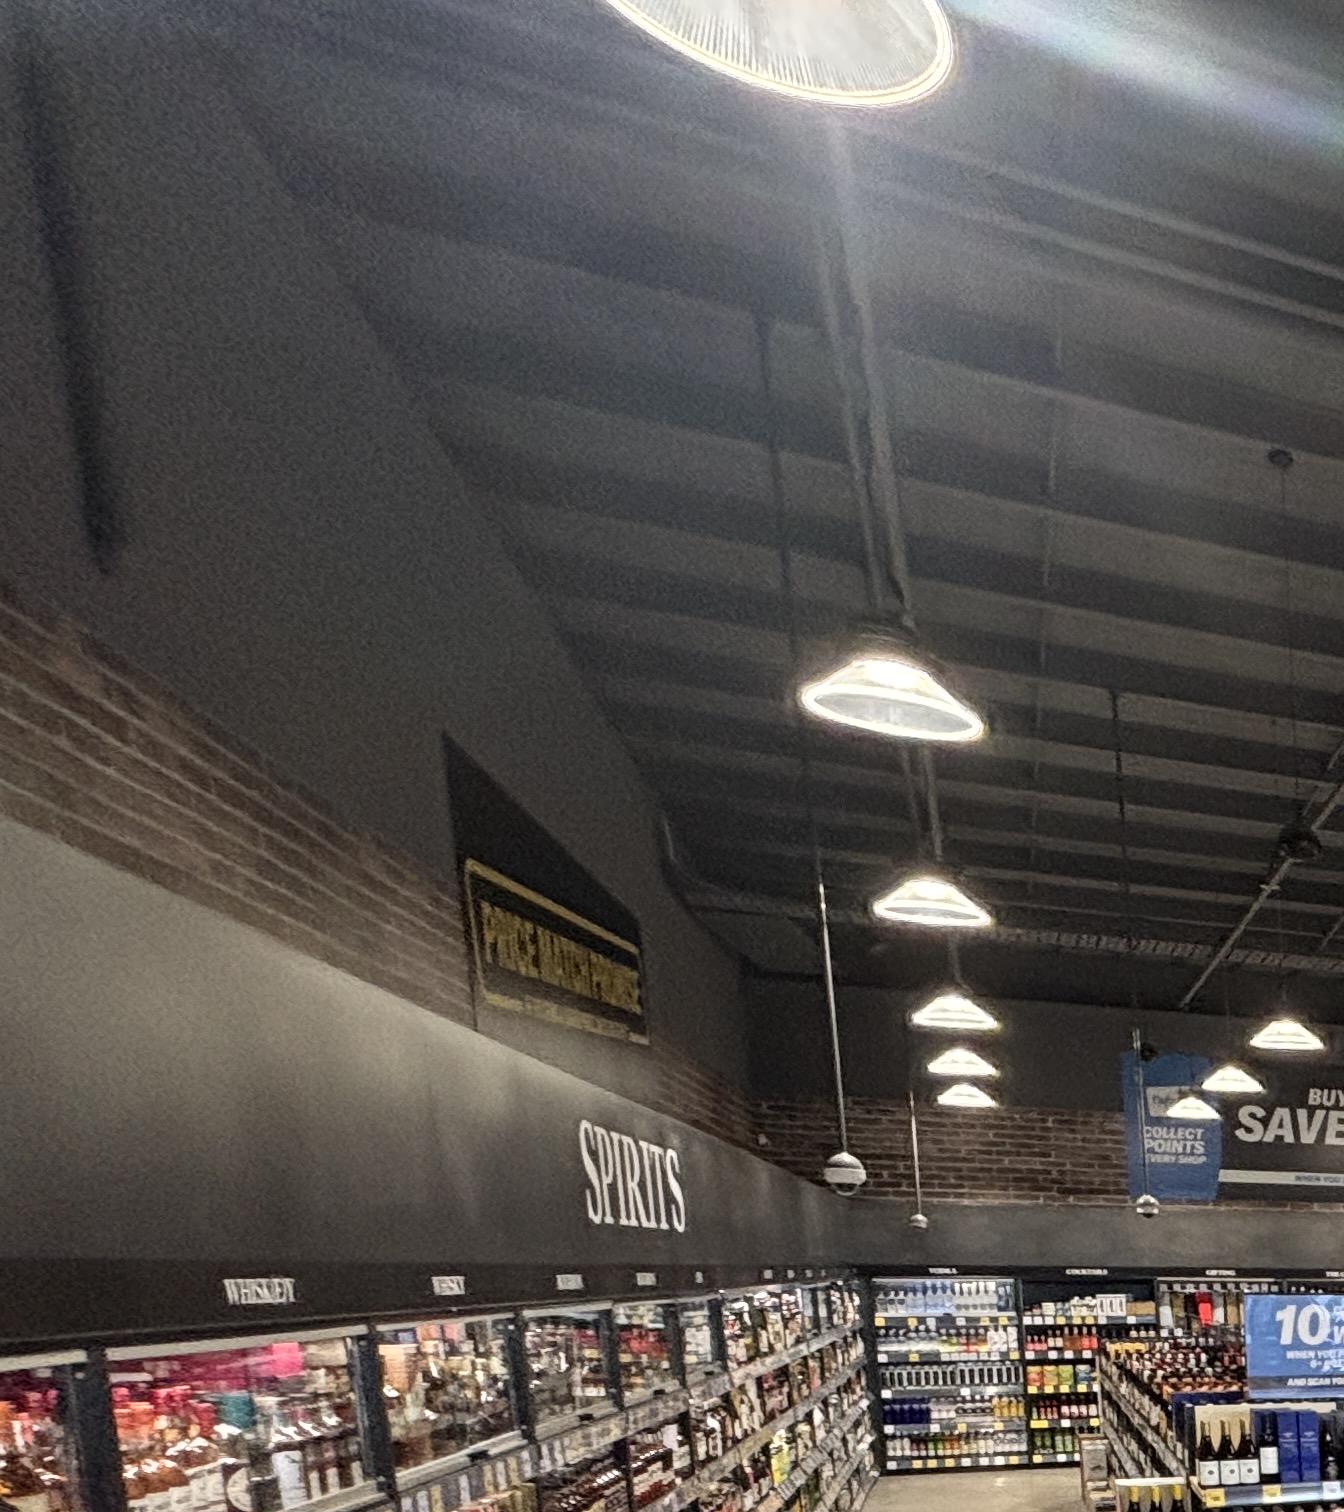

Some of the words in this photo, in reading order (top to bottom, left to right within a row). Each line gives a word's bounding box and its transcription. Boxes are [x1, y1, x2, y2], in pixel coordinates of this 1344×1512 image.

[1144, 1126, 1205, 1140] COLLECT
[1144, 1139, 1205, 1154] POINTS
[579, 1119, 686, 1233] SPIRITS
